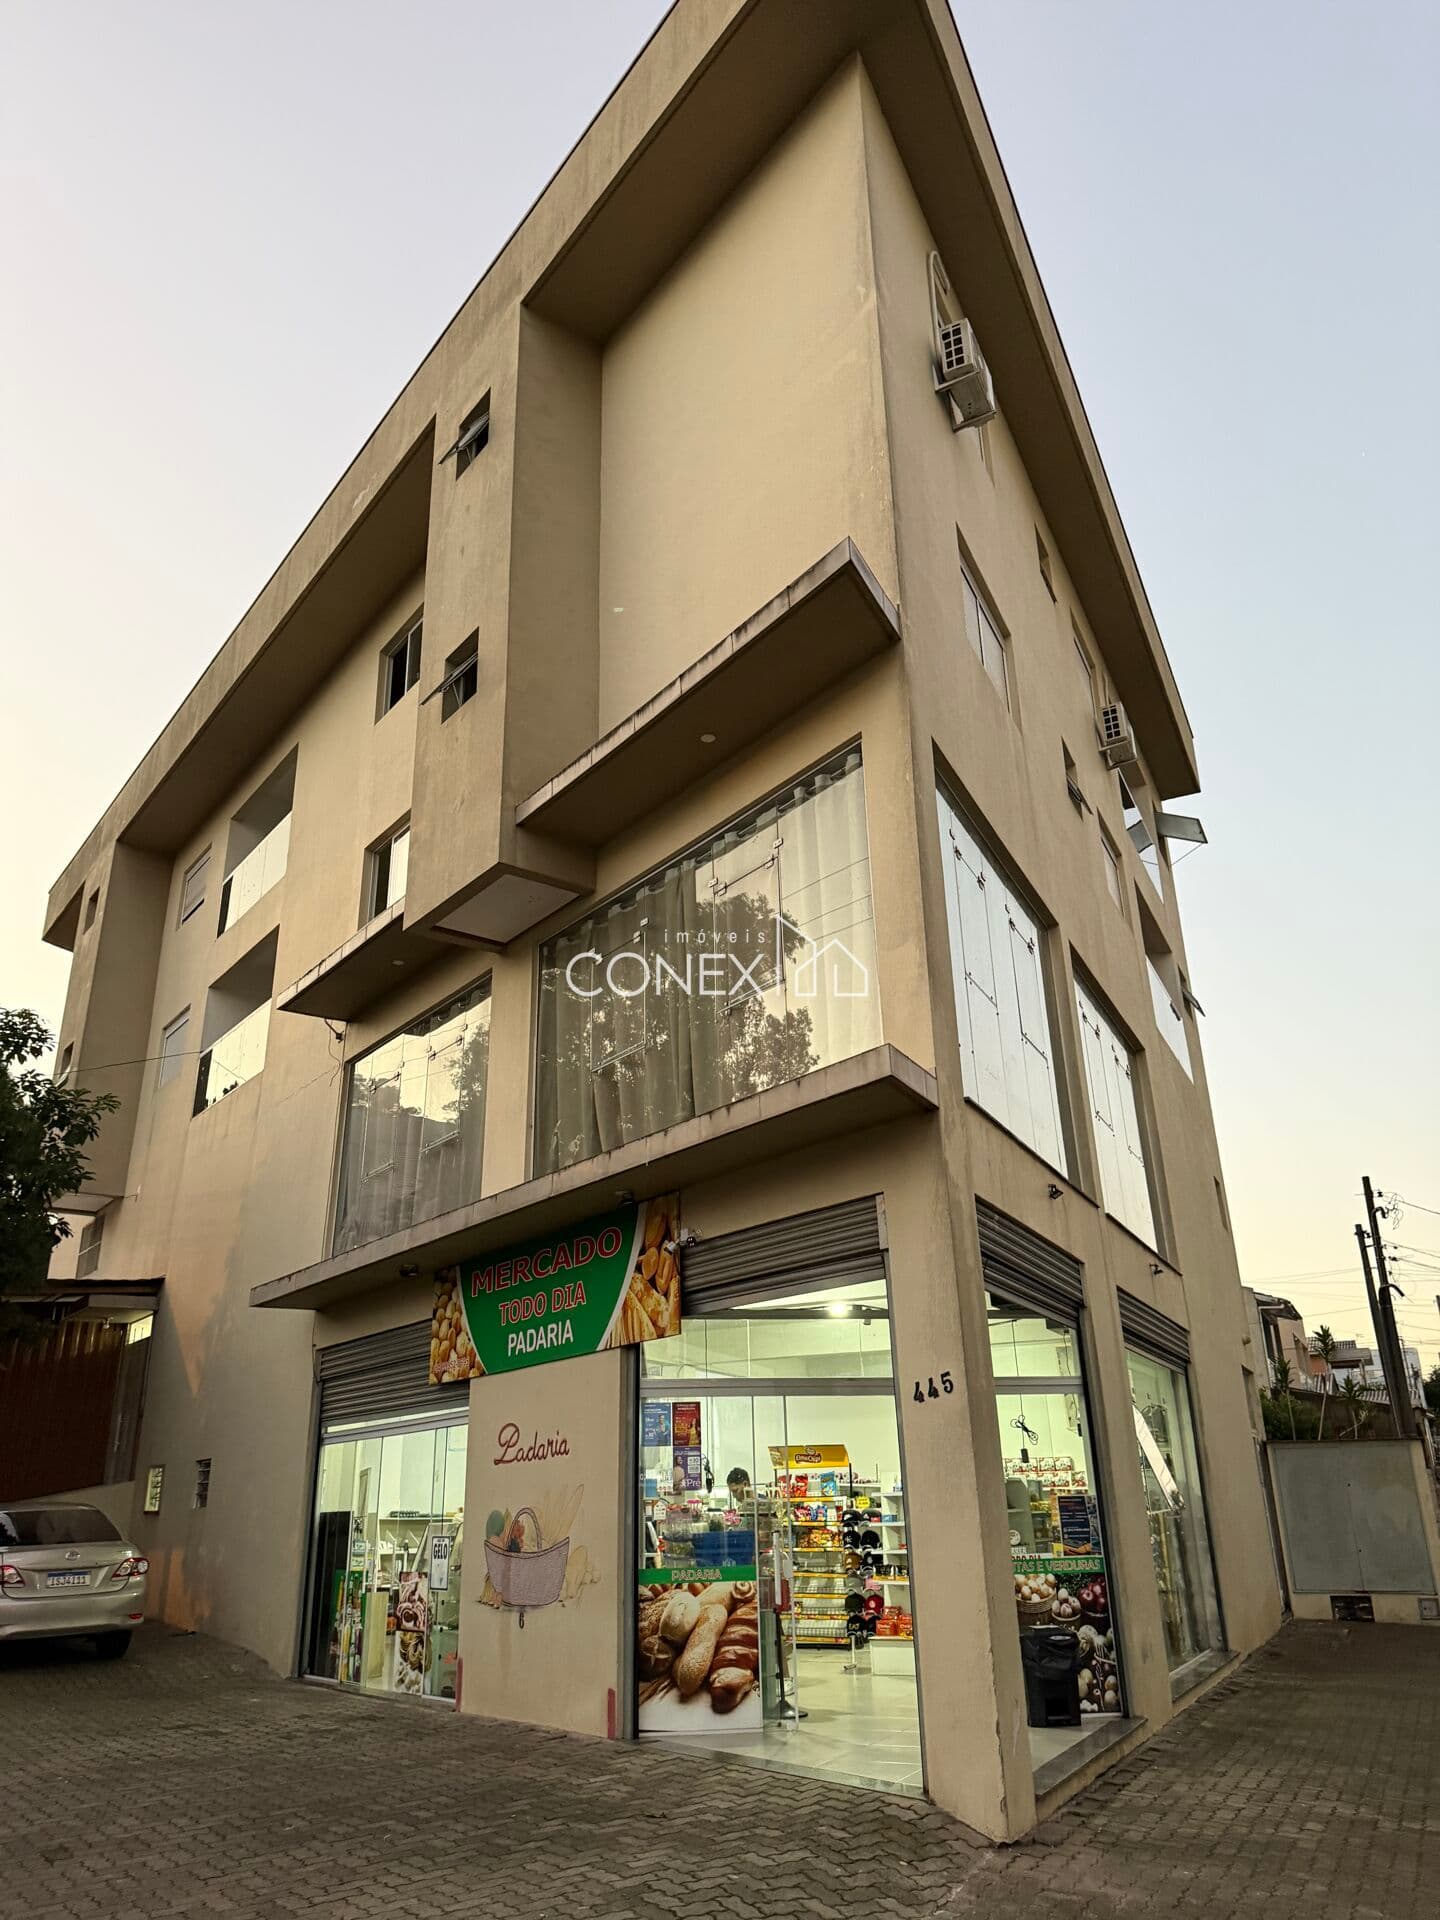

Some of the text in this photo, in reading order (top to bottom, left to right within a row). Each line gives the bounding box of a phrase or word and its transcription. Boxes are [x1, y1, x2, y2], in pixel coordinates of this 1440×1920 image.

[471, 1226, 623, 1297] MERCADO
[499, 1280, 587, 1326] TODO DIA
[507, 1319, 574, 1357] PADARIA
[913, 1370, 954, 1404] 445
[493, 1422, 570, 1466] Padaria
[433, 1543, 448, 1560] GELO
[1013, 1558, 1102, 1572] TAS E VERDURAS
[671, 1568, 722, 1581] PADARIA
